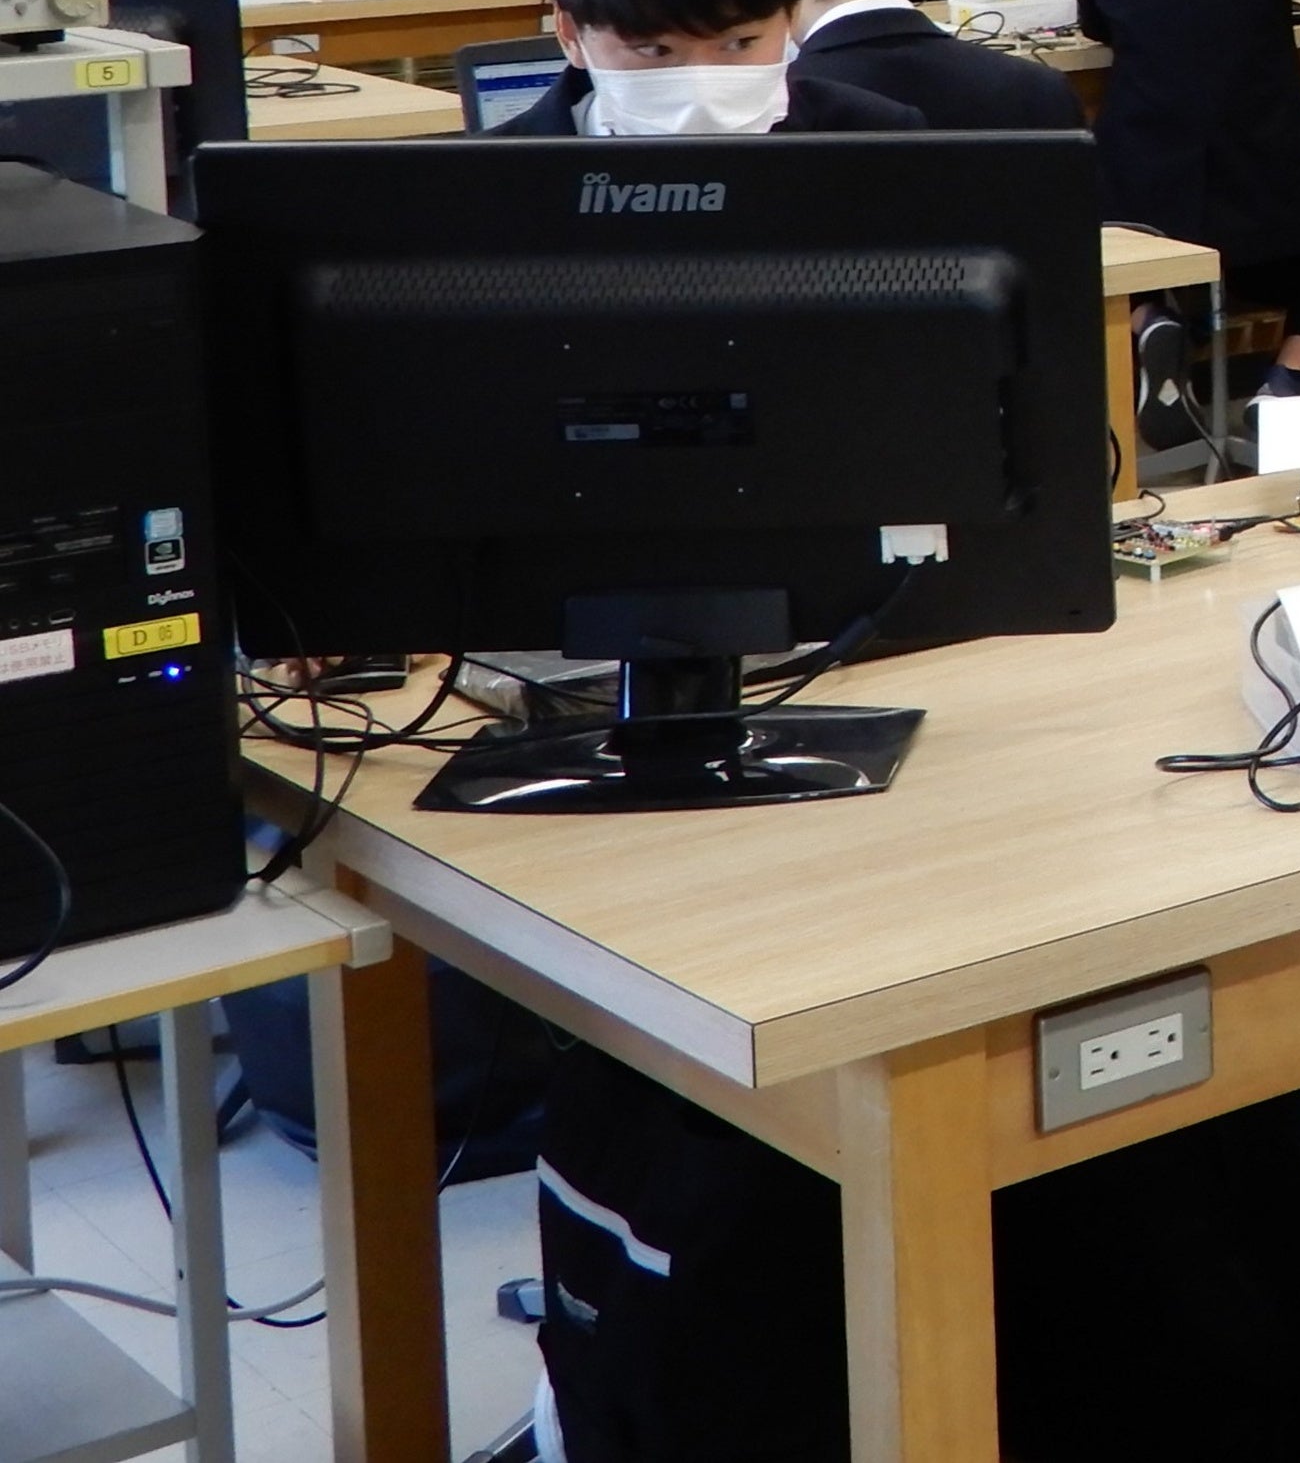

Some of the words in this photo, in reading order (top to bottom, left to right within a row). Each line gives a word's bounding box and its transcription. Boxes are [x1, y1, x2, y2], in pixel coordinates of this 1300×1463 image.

[102, 66, 115, 81] 5
[579, 172, 727, 214] iiyama
[132, 629, 148, 647] D
